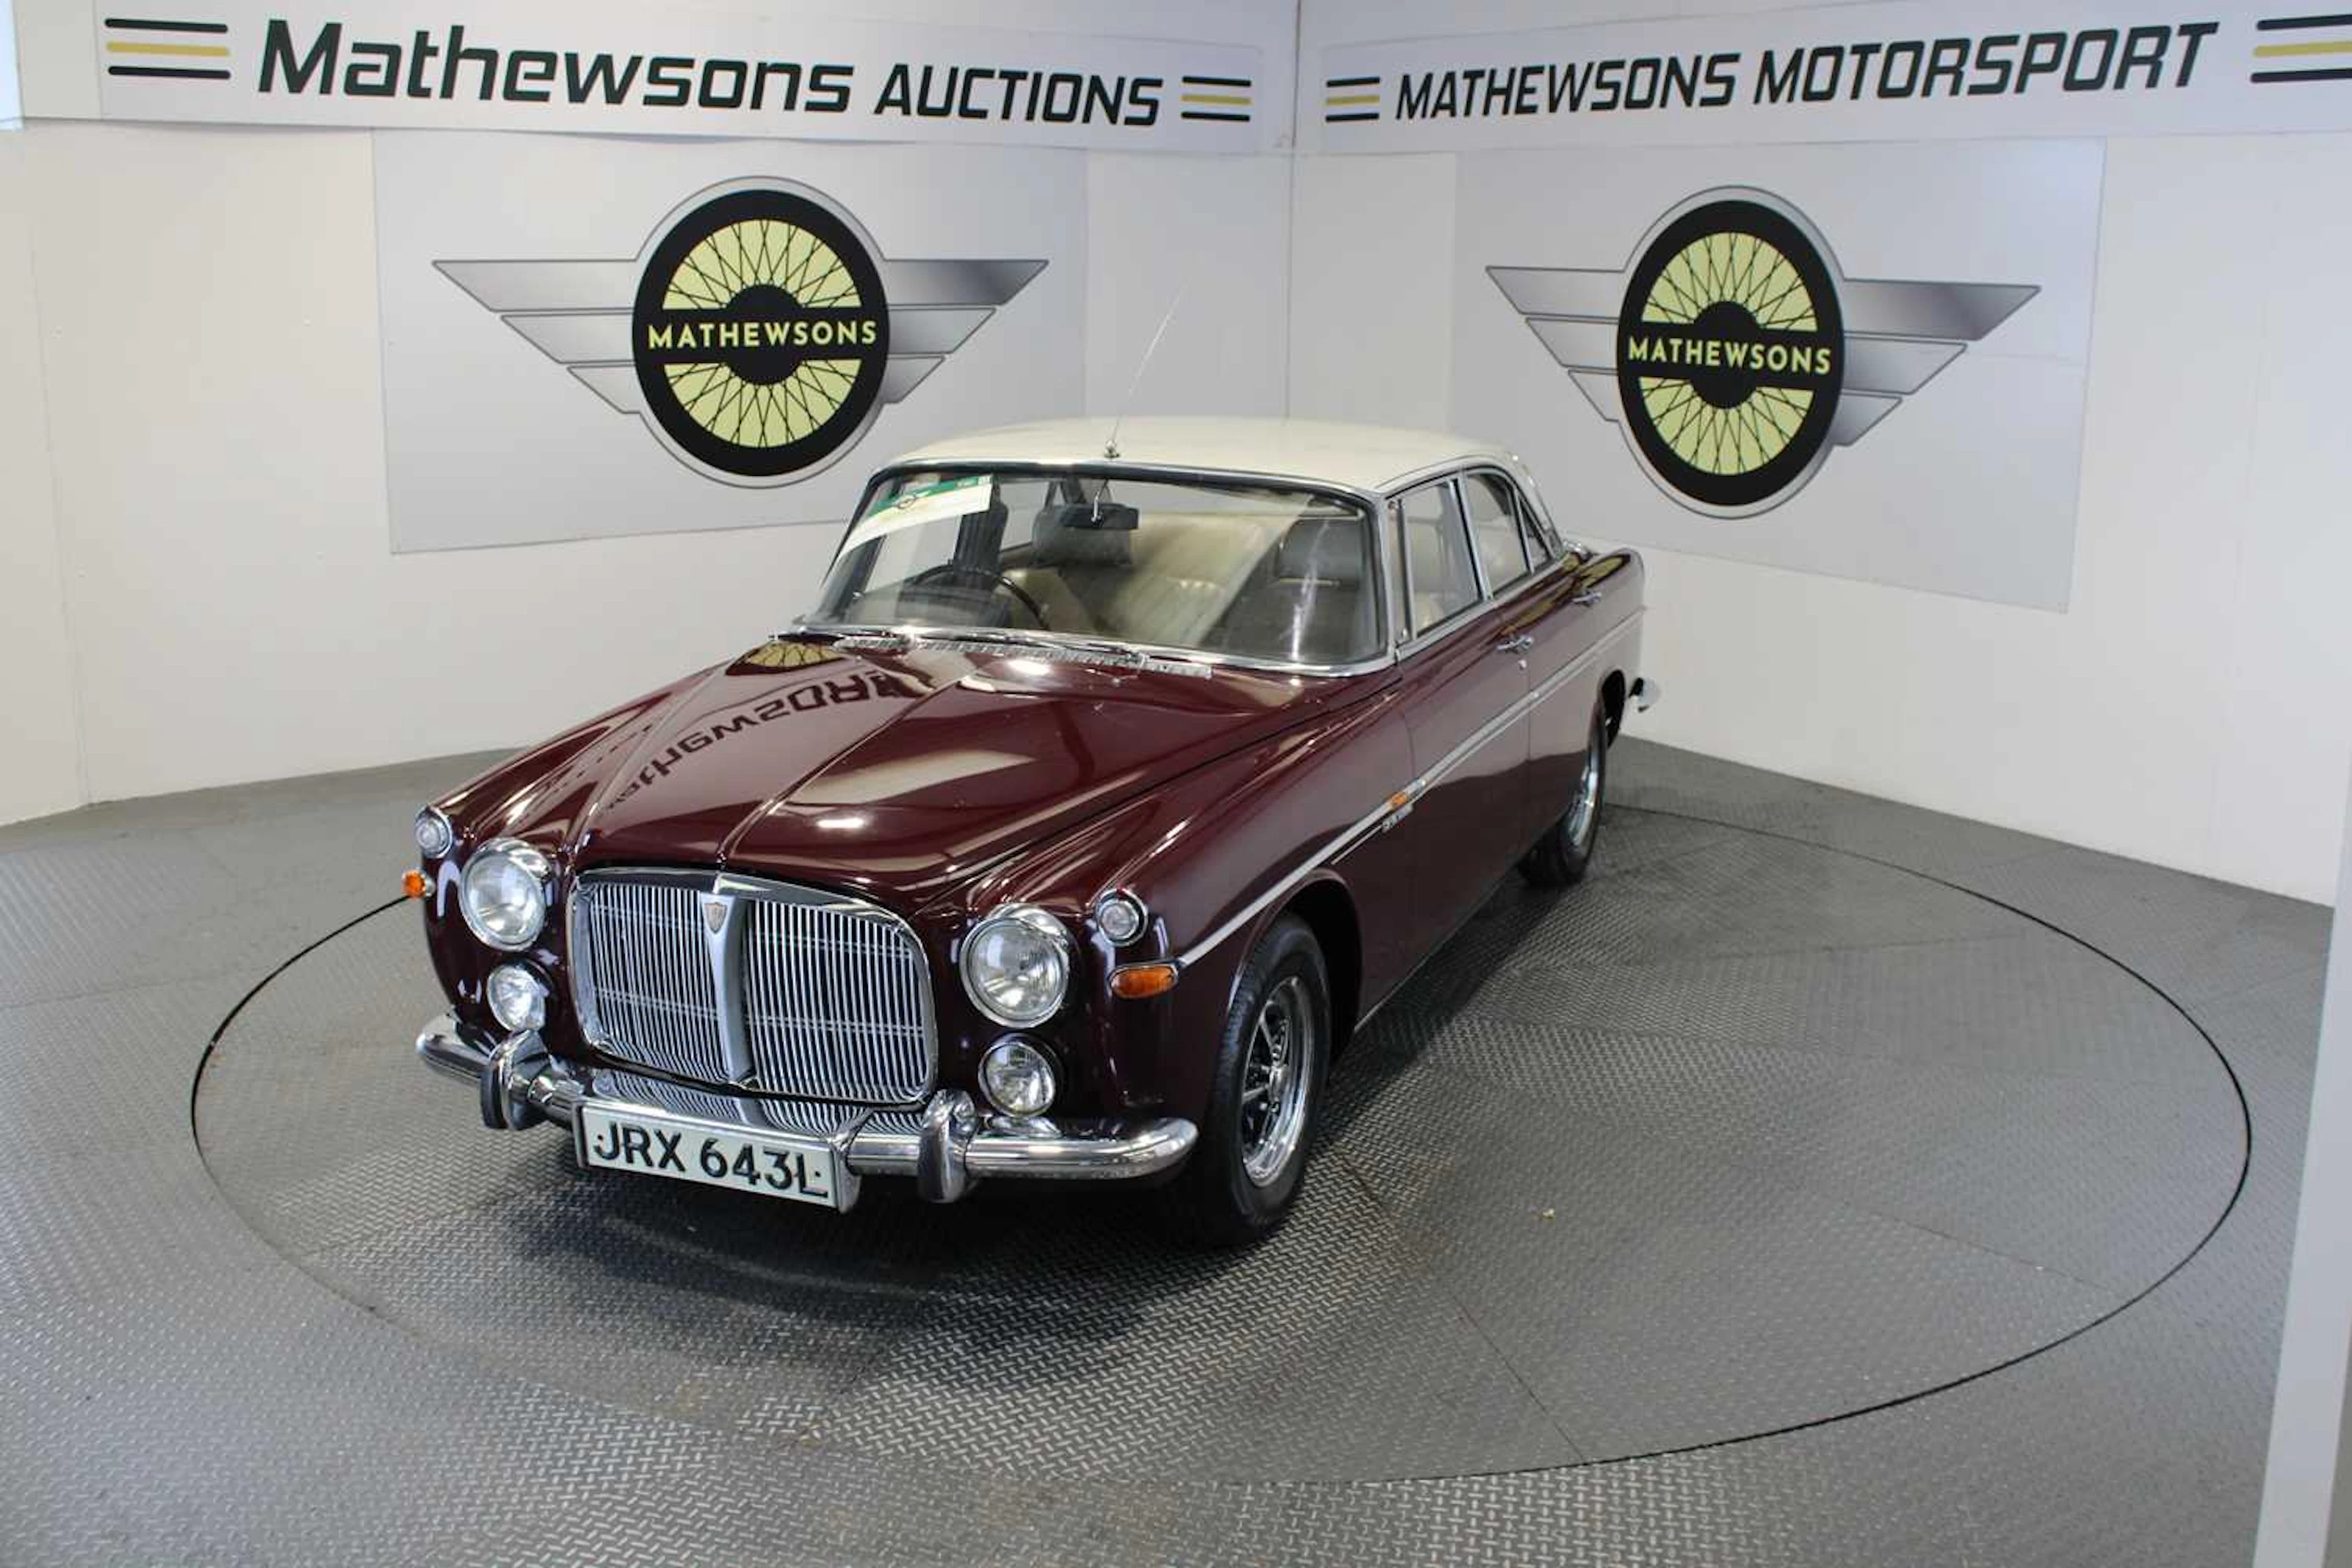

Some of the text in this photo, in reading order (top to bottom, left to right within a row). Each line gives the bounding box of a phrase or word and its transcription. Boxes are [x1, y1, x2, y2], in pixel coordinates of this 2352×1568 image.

[259, 20, 1163, 126] Mathewsons AUCTIONS
[1396, 22, 2220, 119] MATHEWSONS MOTORSPORT
[648, 320, 876, 349] MATHEWSONS
[1629, 337, 1831, 375] MATHEWSONS
[594, 1123, 829, 1197] JRX 643L
